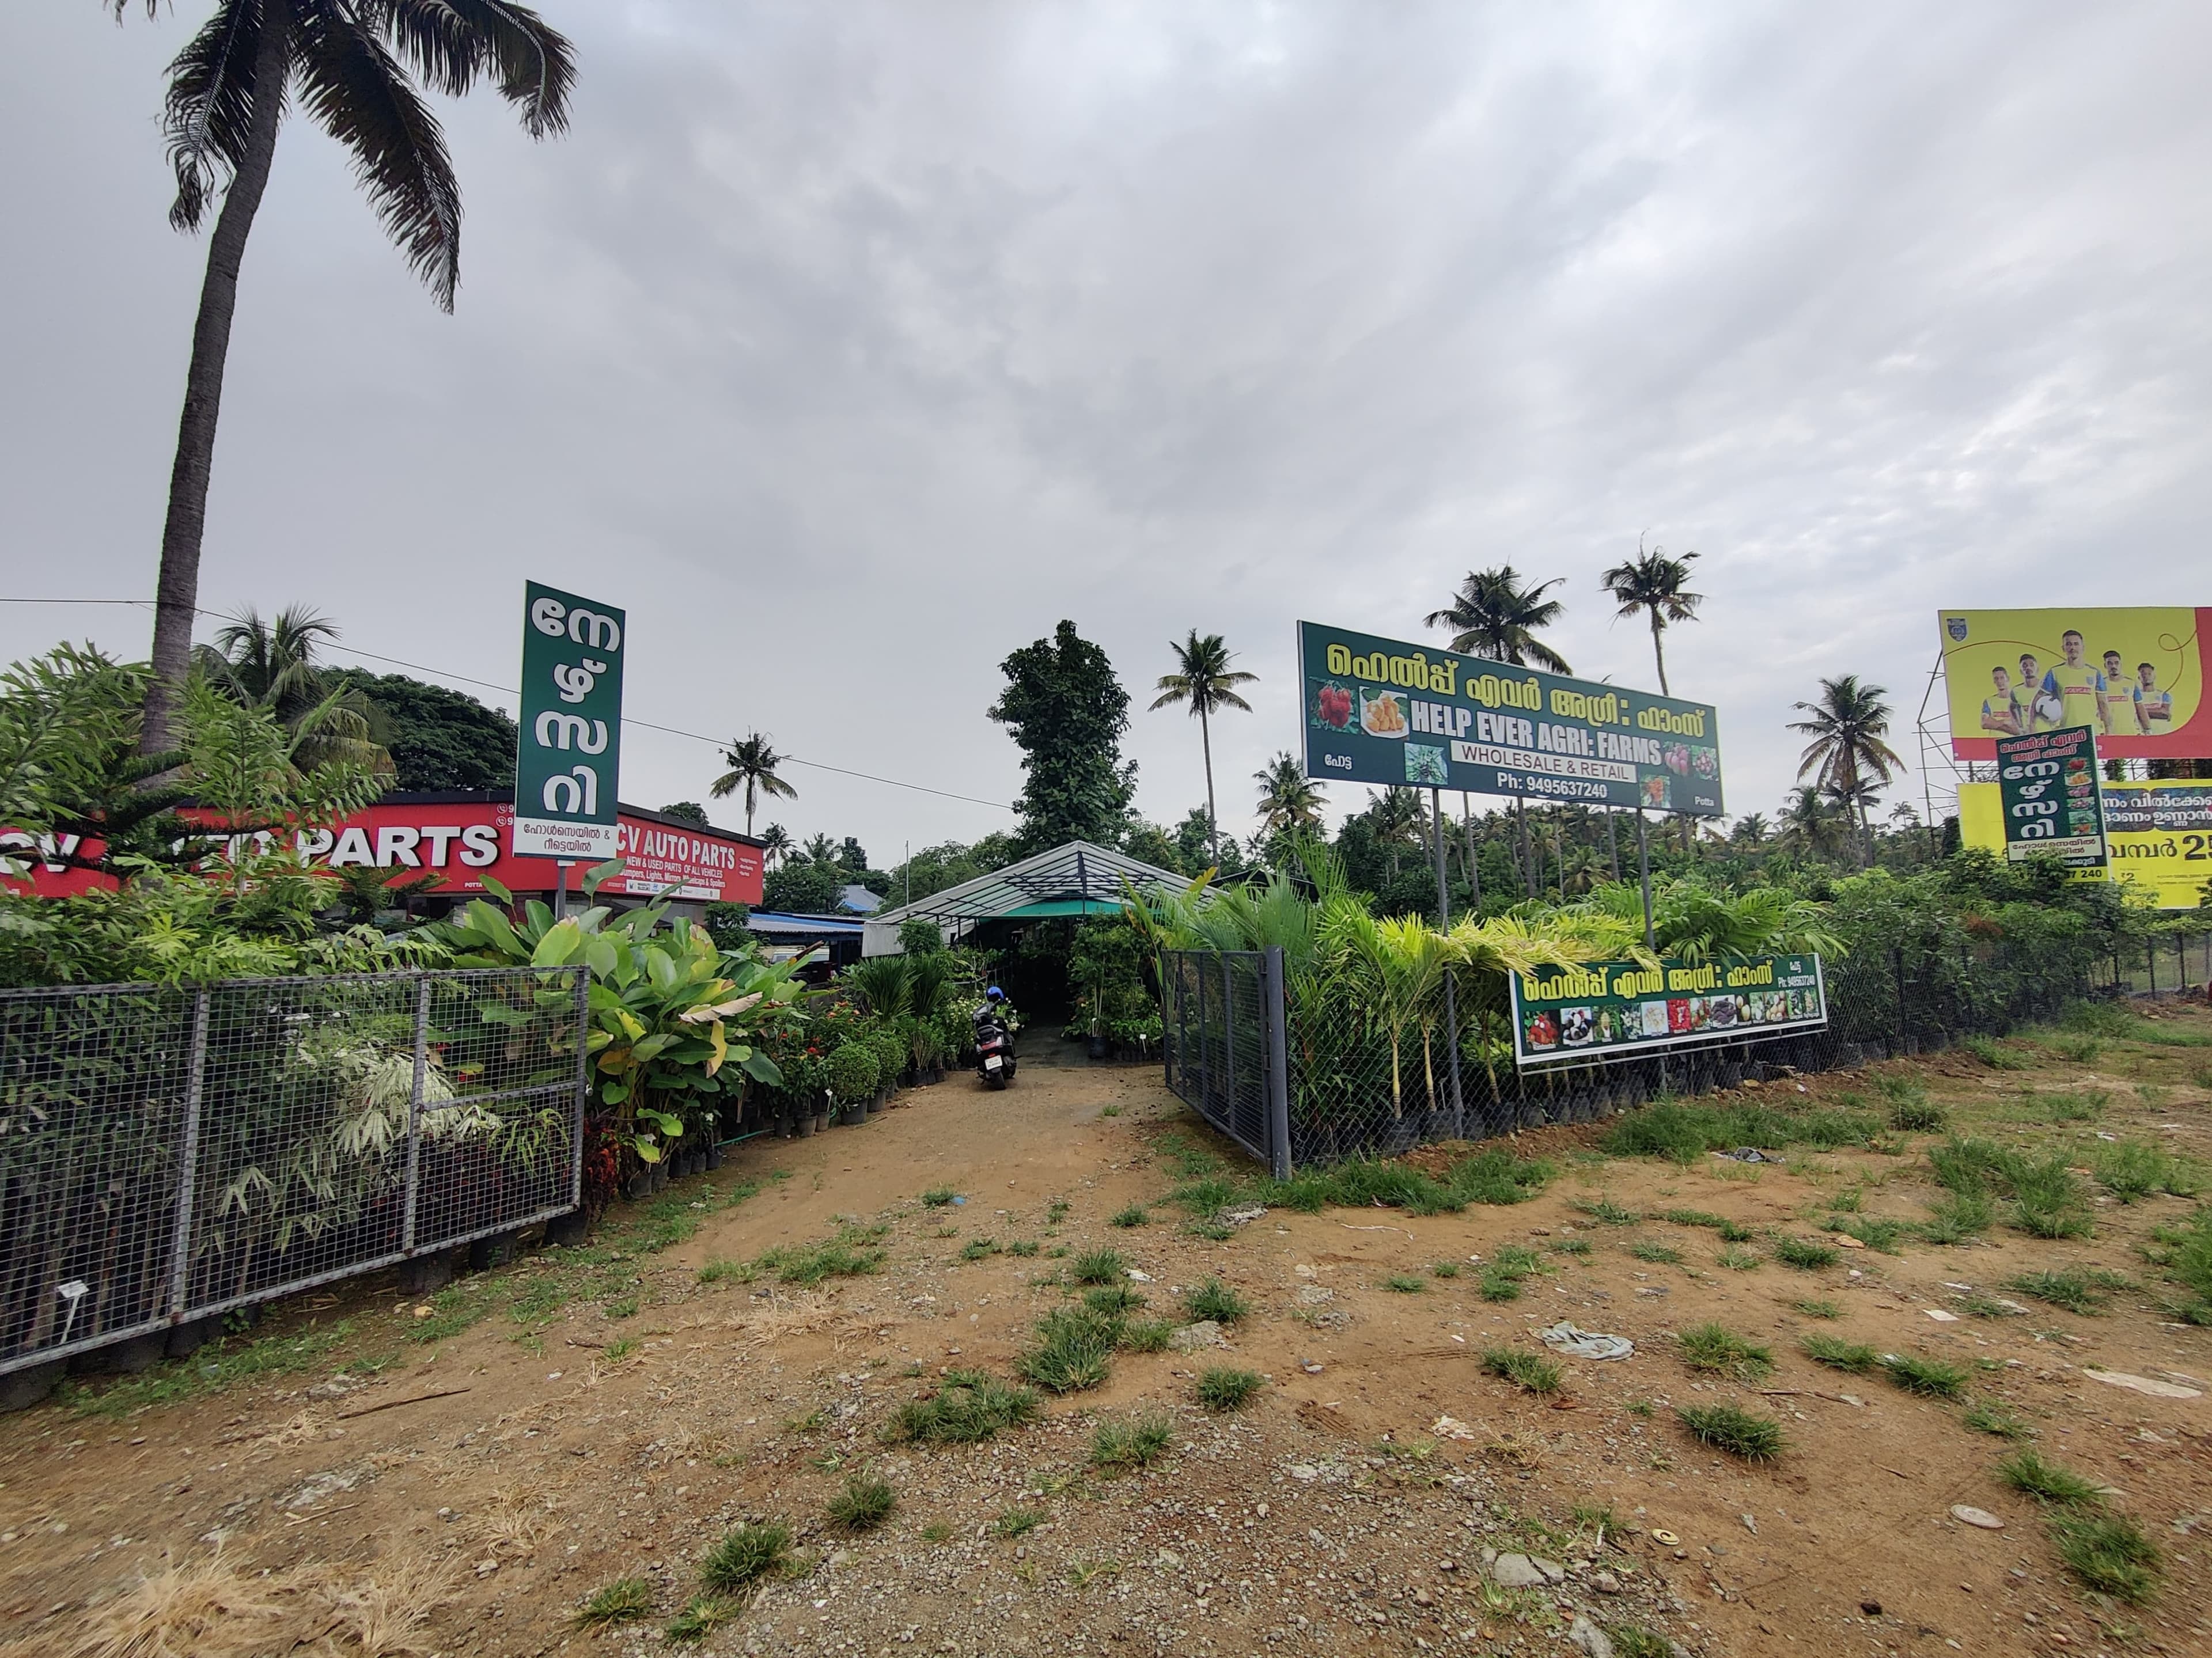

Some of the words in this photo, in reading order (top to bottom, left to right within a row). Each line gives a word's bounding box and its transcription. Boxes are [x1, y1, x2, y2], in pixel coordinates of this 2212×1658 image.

[1410, 699, 1472, 738] HELP
[1476, 710, 1535, 749] EVER
[1537, 721, 1595, 757] AGRI:
[1596, 730, 1663, 766] FARMS
[1461, 745, 1562, 773] WHOLESALE
[1566, 761, 1577, 774] &
[1580, 762, 1630, 780] RETAIL
[1497, 772, 1524, 791] Ph:
[1525, 776, 1608, 799] 9495637240
[1694, 795, 1715, 807] Potta
[297, 825, 498, 868] PARTS
[604, 830, 610, 840] &
[616, 822, 641, 853] CV
[643, 830, 689, 862] AUTO
[692, 840, 735, 870] PARTS
[2182, 834, 2212, 860] 2
[627, 856, 641, 866] NEW
[642, 859, 646, 867] &
[648, 860, 664, 870] USED
[665, 862, 681, 872] PARTS
[684, 864, 691, 873] OF
[691, 866, 701, 875] ALL
[701, 868, 723, 878] VEHICLES
[2081, 869, 2102, 878] 240
